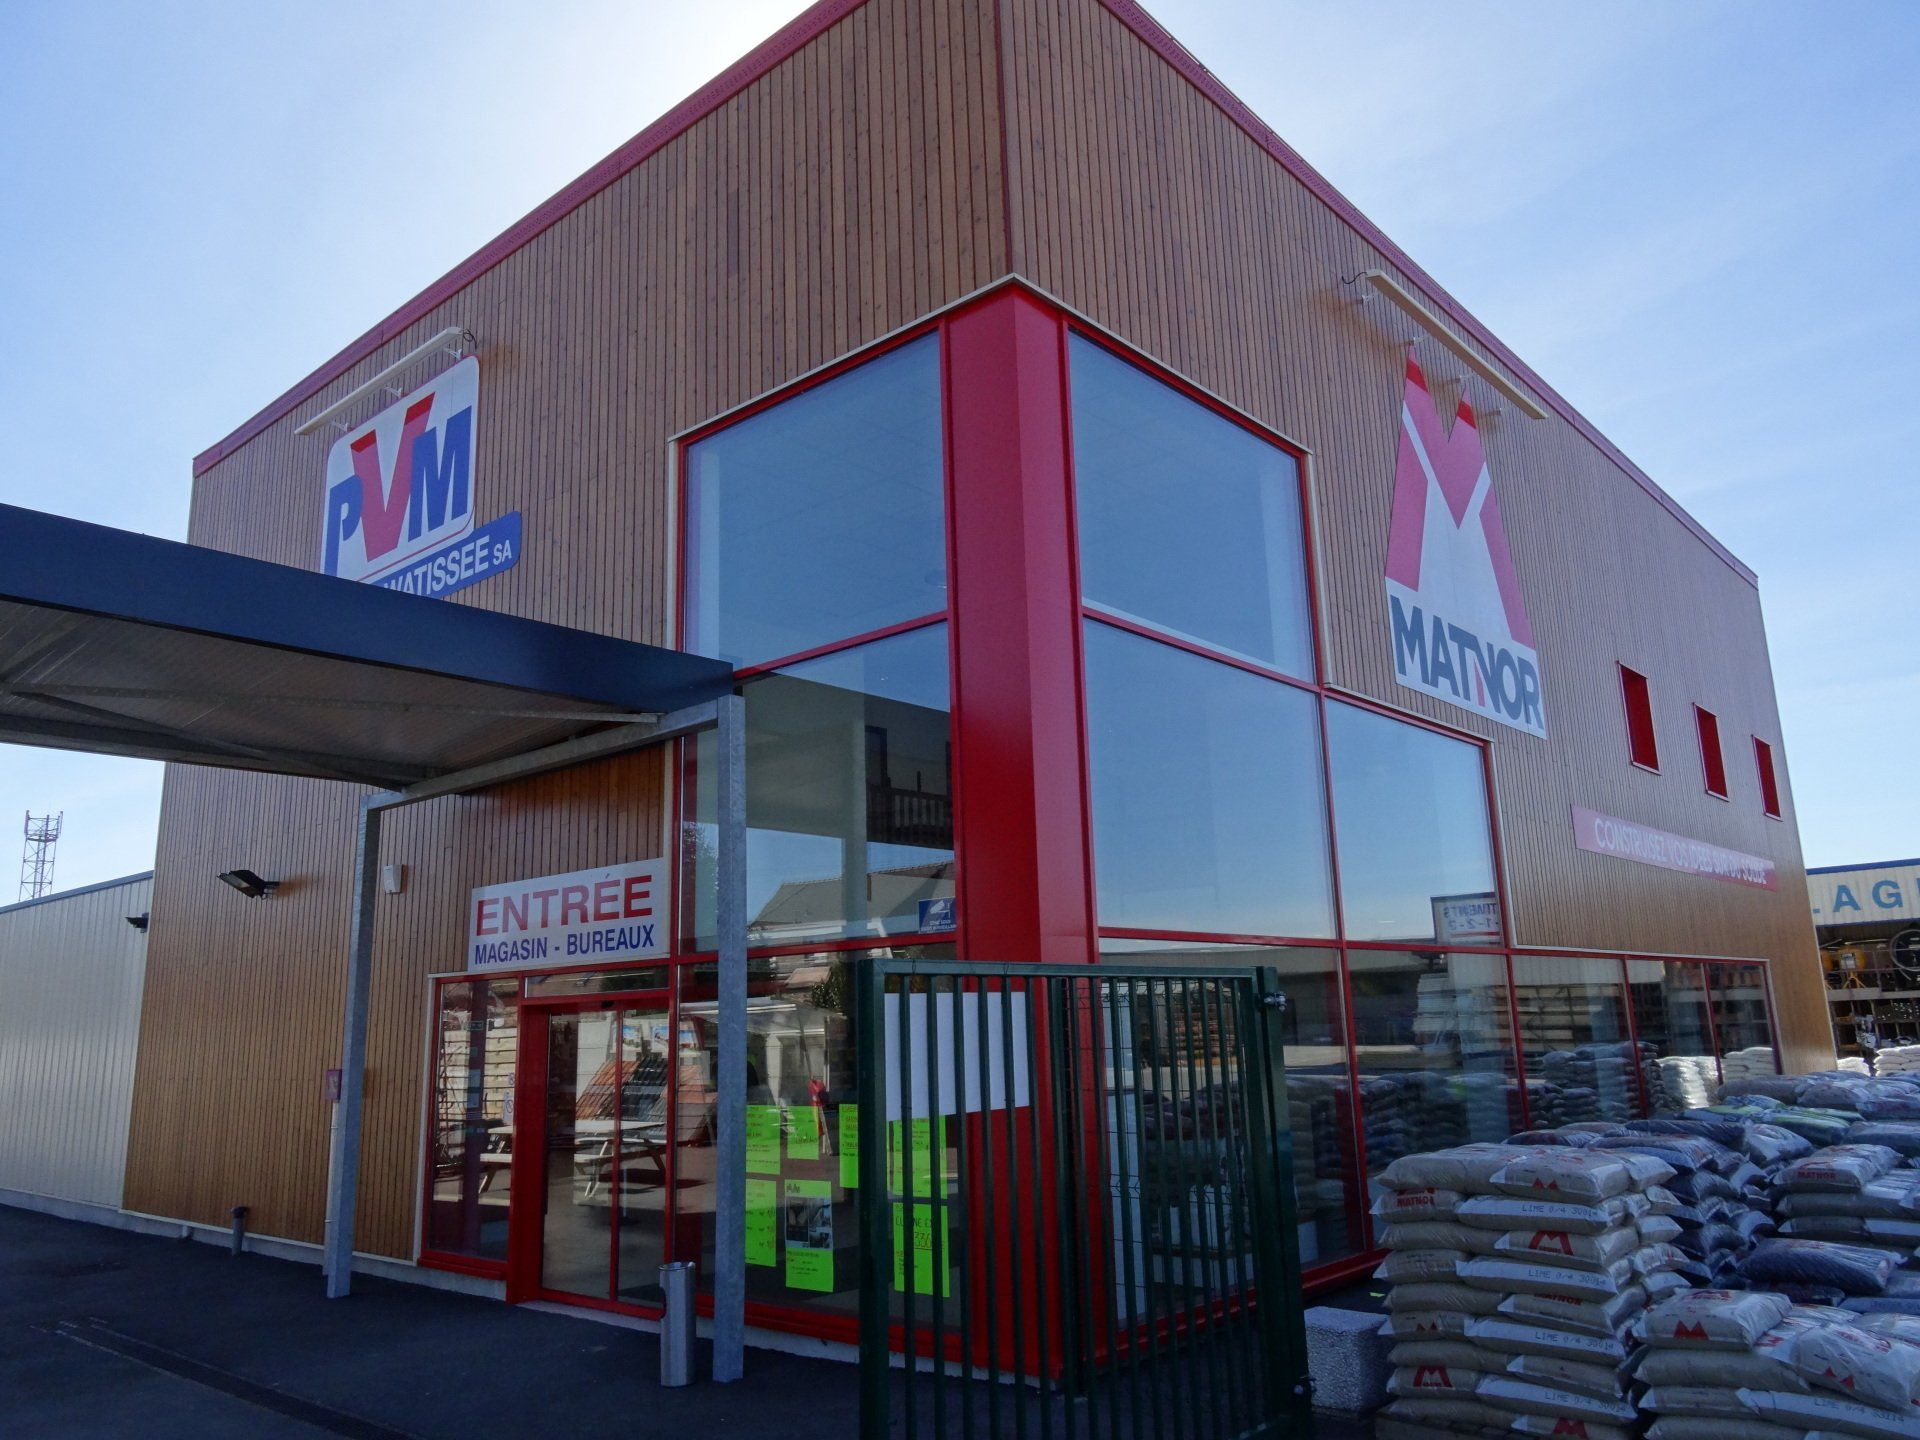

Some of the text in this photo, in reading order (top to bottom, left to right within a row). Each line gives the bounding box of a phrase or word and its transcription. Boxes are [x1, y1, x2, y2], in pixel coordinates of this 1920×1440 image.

[324, 392, 472, 577] PVM
[493, 540, 512, 565] SA
[1390, 594, 1545, 730] MATNOR
[476, 873, 652, 936] ENTRÉE
[475, 937, 547, 965] MAGASIN
[567, 924, 655, 955] BUREAUX
